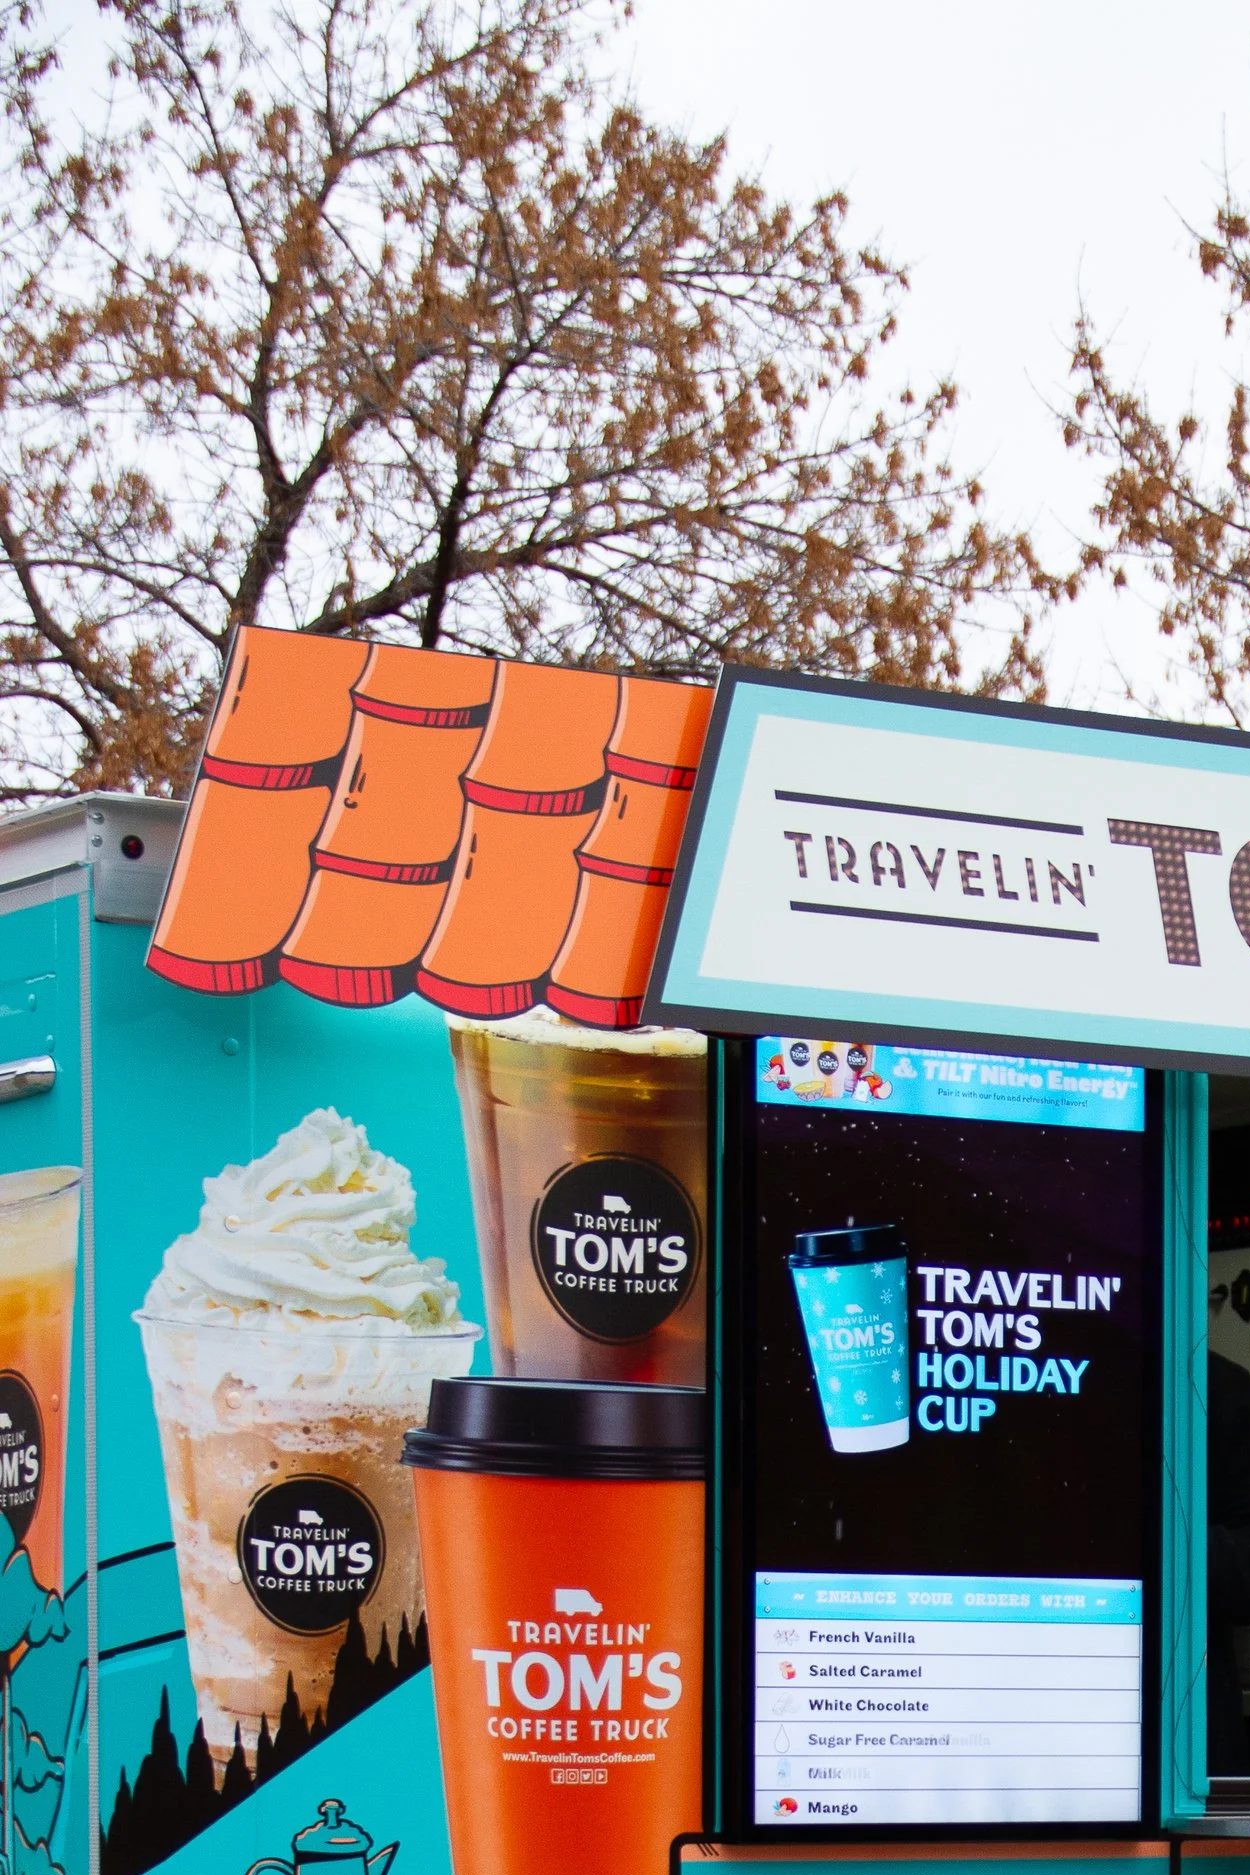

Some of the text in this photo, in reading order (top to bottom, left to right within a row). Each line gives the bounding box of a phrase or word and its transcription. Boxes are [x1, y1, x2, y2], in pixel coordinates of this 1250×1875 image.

[782, 831, 1099, 909] TRAVELIN'
[892, 1058, 917, 1079] &
[923, 1059, 976, 1083] TILT
[980, 1065, 1044, 1089] Nitro
[937, 1088, 953, 1097] Pair
[962, 1090, 977, 1099] with
[993, 1093, 1006, 1101] fun
[1007, 1095, 1021, 1103] and
[1022, 1096, 1060, 1106] refreshing
[574, 1212, 661, 1232] TRAVELIN'
[545, 1226, 688, 1274] TOM'S
[555, 1272, 679, 1293] COFFEE TRUCK
[917, 1266, 1121, 1311] TRAVELIN'
[820, 1322, 894, 1351] TOM'S
[917, 1310, 1042, 1351] TOM'S
[828, 1347, 892, 1361] COFFEE TRUCK
[918, 1352, 1089, 1394] HOLIDAY
[918, 1395, 996, 1432] CUP
[9, 1487, 36, 1508] TRUCK
[273, 1525, 350, 1540] TRAVELIN'
[250, 1538, 373, 1576] TOM'S
[257, 1576, 365, 1592] COFFEE TRUCK
[815, 1590, 1086, 1609] ENHANCE YOUR ORDERS WITH
[507, 1620, 651, 1646] TRAVELIN'
[809, 1630, 916, 1645] French Vanilla
[471, 1648, 683, 1711] TOM'S
[808, 1664, 922, 1679] Salted Caramel
[808, 1699, 929, 1713] White Chocolate
[487, 1716, 670, 1741] COFFEE TRUCK
[808, 1733, 852, 1749] Sugar
[856, 1733, 887, 1747] Free
[503, 1751, 656, 1764] www.TravelinTomsCoffee.com
[808, 1801, 858, 1817] Mango
